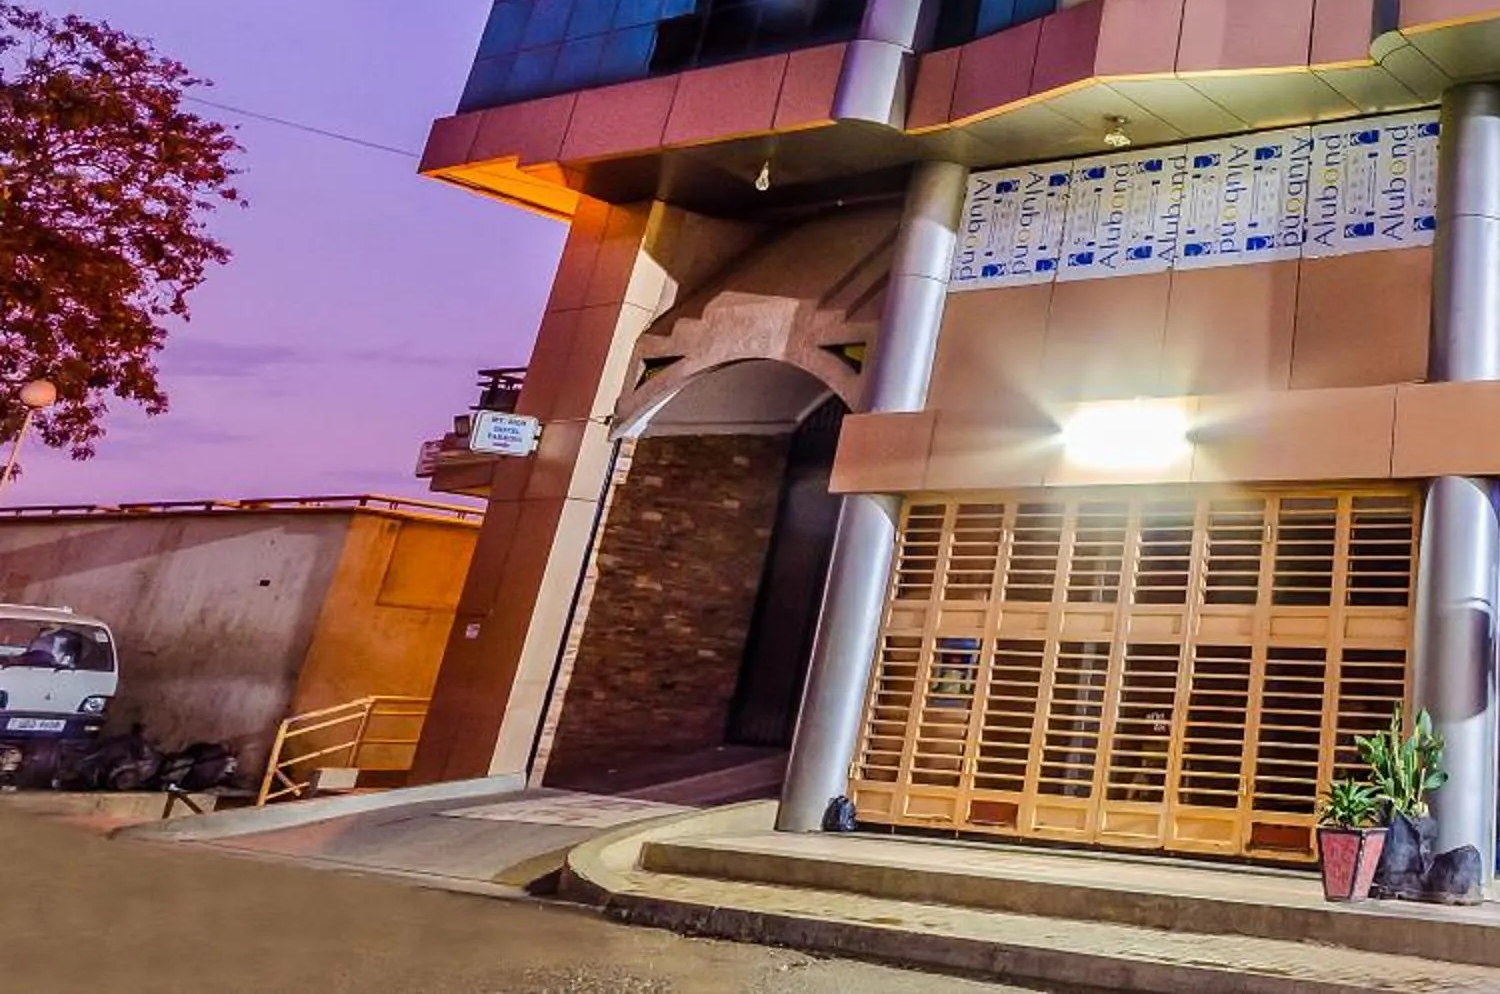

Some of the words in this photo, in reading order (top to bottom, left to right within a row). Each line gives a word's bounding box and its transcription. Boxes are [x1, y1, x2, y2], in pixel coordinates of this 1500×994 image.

[958, 178, 993, 280] Alubond
[1012, 171, 1045, 275] Alubond
[1099, 162, 1130, 269] Alubond
[1219, 143, 1250, 254] Alubond
[1312, 133, 1342, 247] Alubond
[1380, 125, 1409, 241] Alubond
